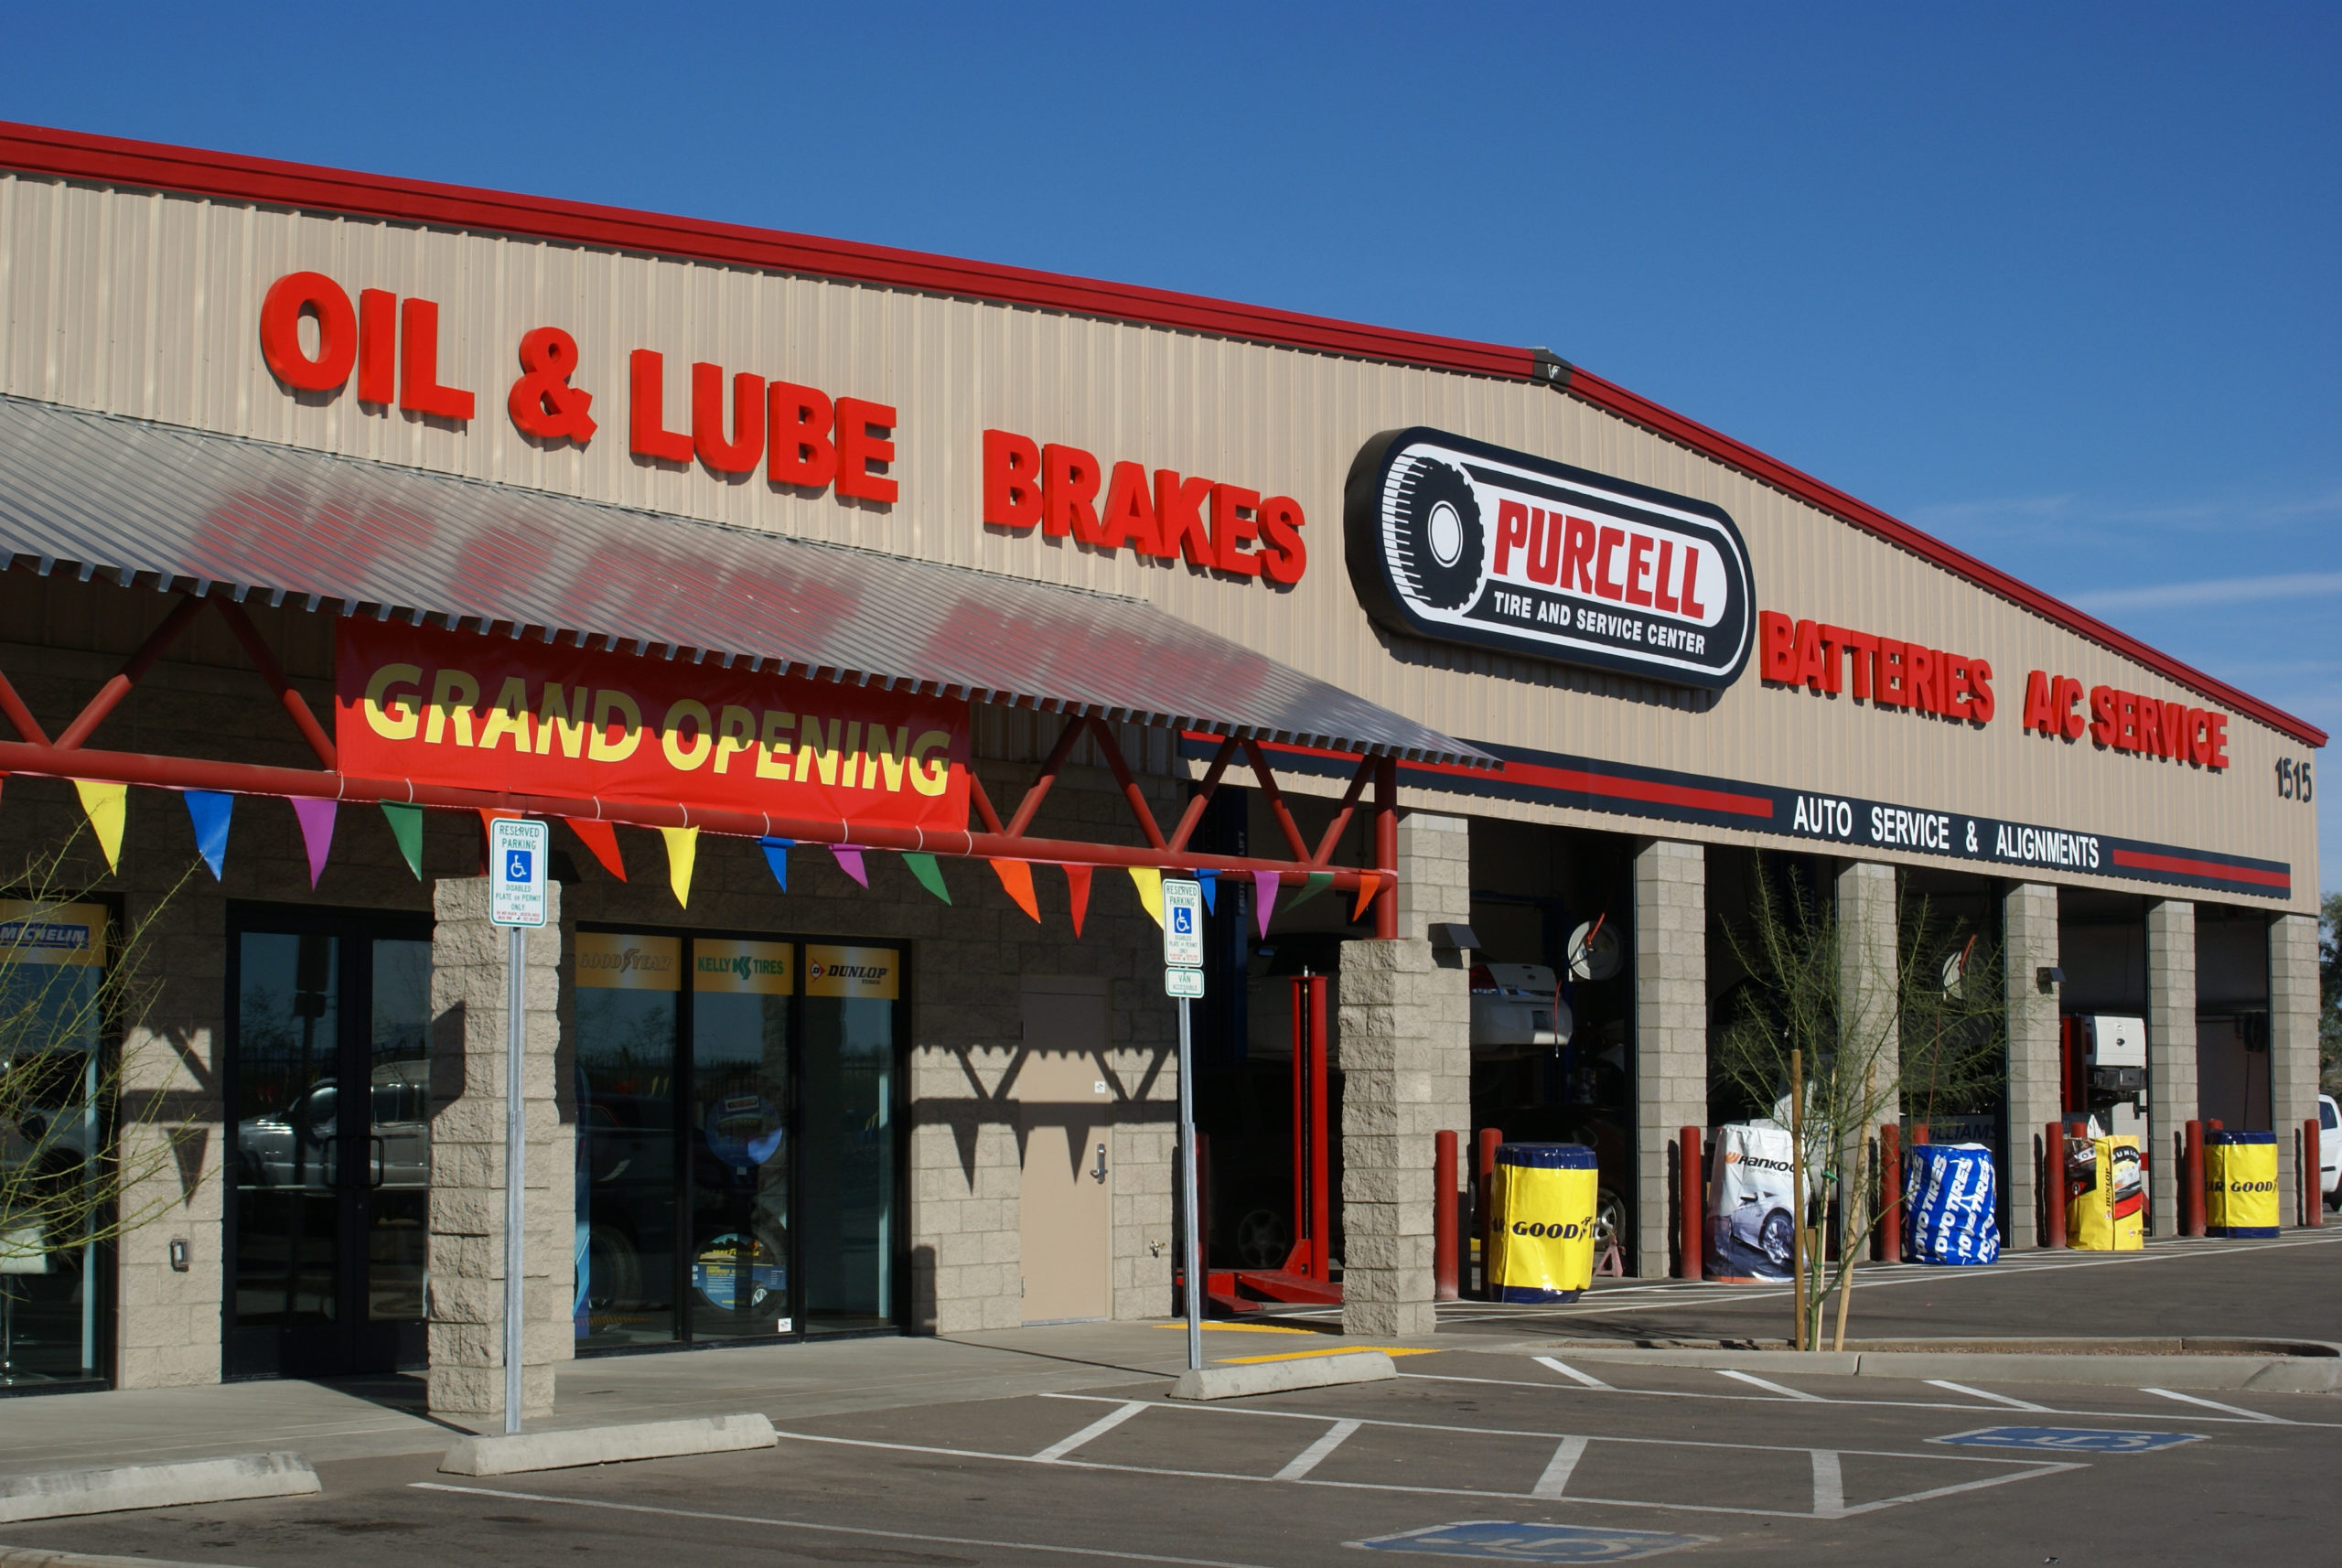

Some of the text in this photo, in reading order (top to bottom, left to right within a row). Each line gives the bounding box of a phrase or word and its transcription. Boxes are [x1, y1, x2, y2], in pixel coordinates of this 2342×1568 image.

[261, 271, 898, 504] OIL & LUBE
[983, 428, 1306, 585] BRAKES
[1493, 499, 1704, 619] PURCELL
[1494, 591, 1705, 655] TIRE AND SERVICE CENTER
[1759, 610, 1995, 724] BATTERIES
[363, 662, 951, 797] GRAND OPENING
[2024, 670, 2229, 769] A/C SERVICE
[2275, 756, 2313, 803] 1515
[499, 824, 540, 838] RESERVED
[501, 837, 537, 850] PARKING
[1793, 795, 2100, 869] AUTO SERVICE & ALIGNMENTS
[495, 893, 511, 901] PLATE
[1166, 885, 1198, 897] RESERVED
[1169, 896, 1195, 907] PARKING
[0, 925, 87, 942] MICHELIN
[577, 948, 673, 972] GOODYEAR
[697, 956, 731, 972] KELLY
[754, 959, 784, 976] TIRES
[827, 965, 888, 979] DUNLOP
[1178, 975, 1191, 983] VAN
[1928, 1123, 1997, 1140] ILLIAMS
[1922, 1154, 1948, 1212] TIRES
[1946, 1157, 1973, 1212] TIRES
[1970, 1155, 1991, 1213] TIRES
